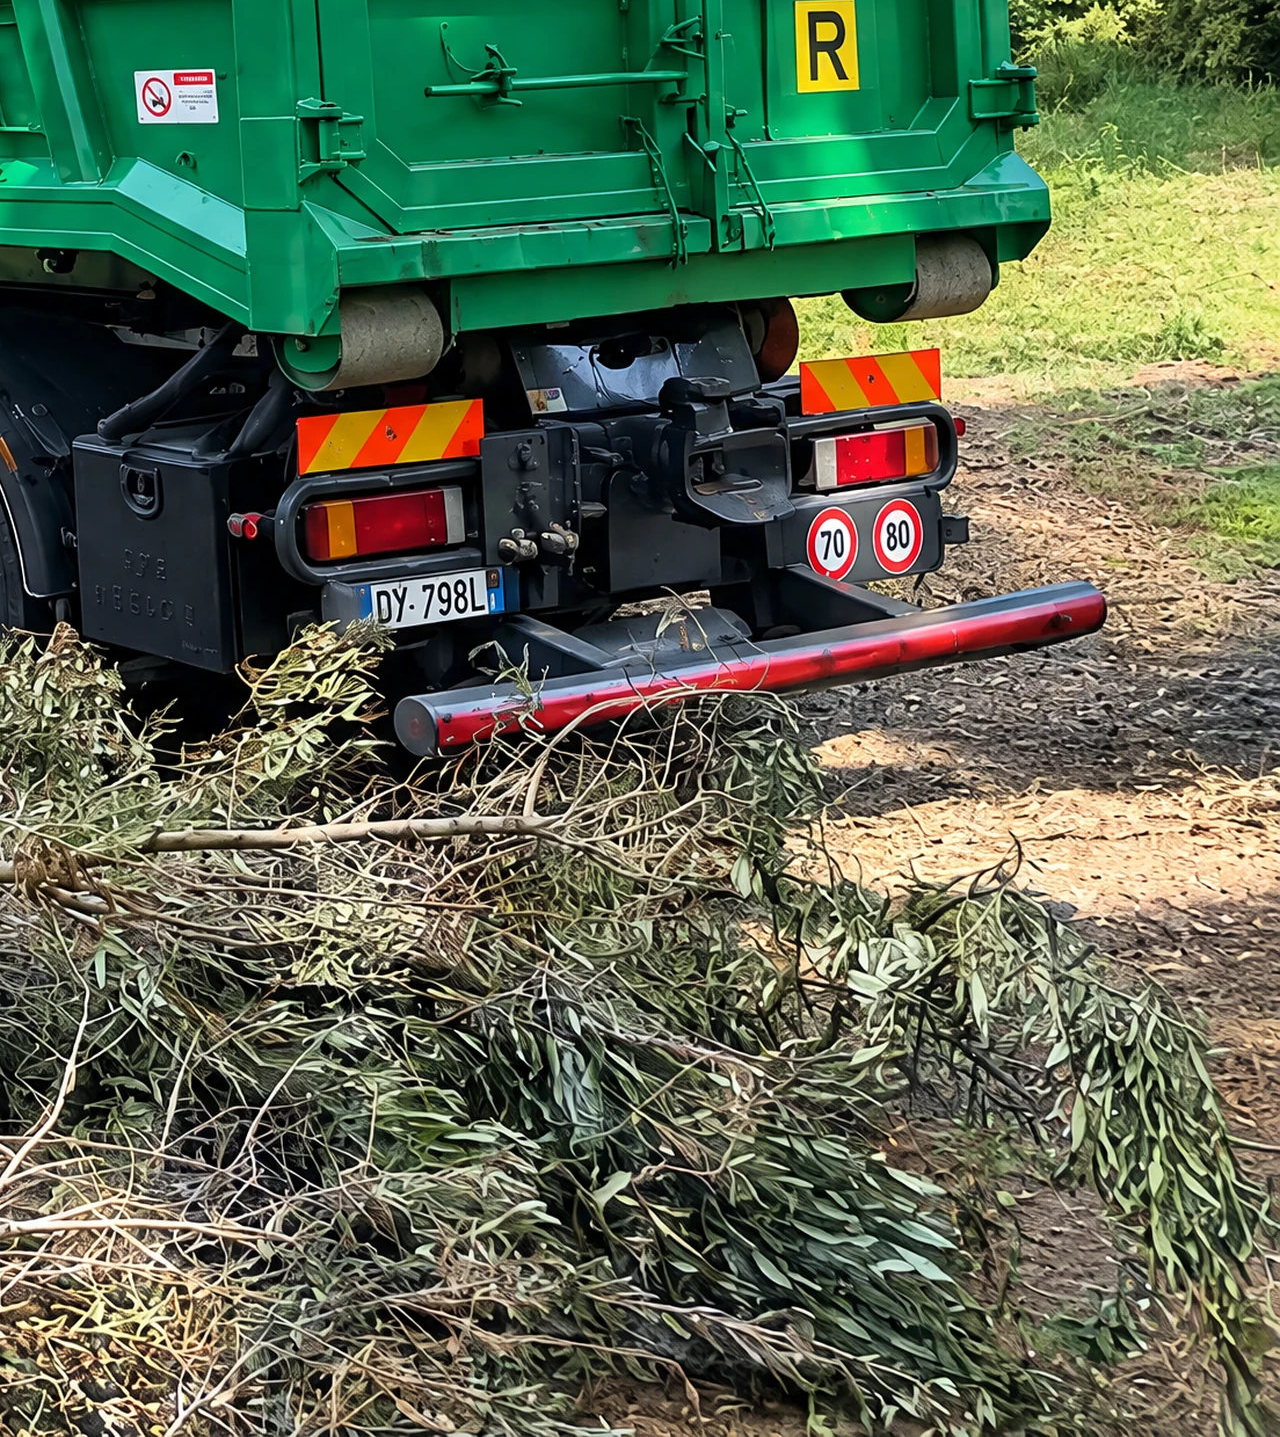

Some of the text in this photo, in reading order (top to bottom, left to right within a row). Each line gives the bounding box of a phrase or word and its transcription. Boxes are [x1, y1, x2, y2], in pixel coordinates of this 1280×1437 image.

[807, 10, 849, 81] R
[820, 528, 844, 560] 70
[886, 519, 910, 551] 80
